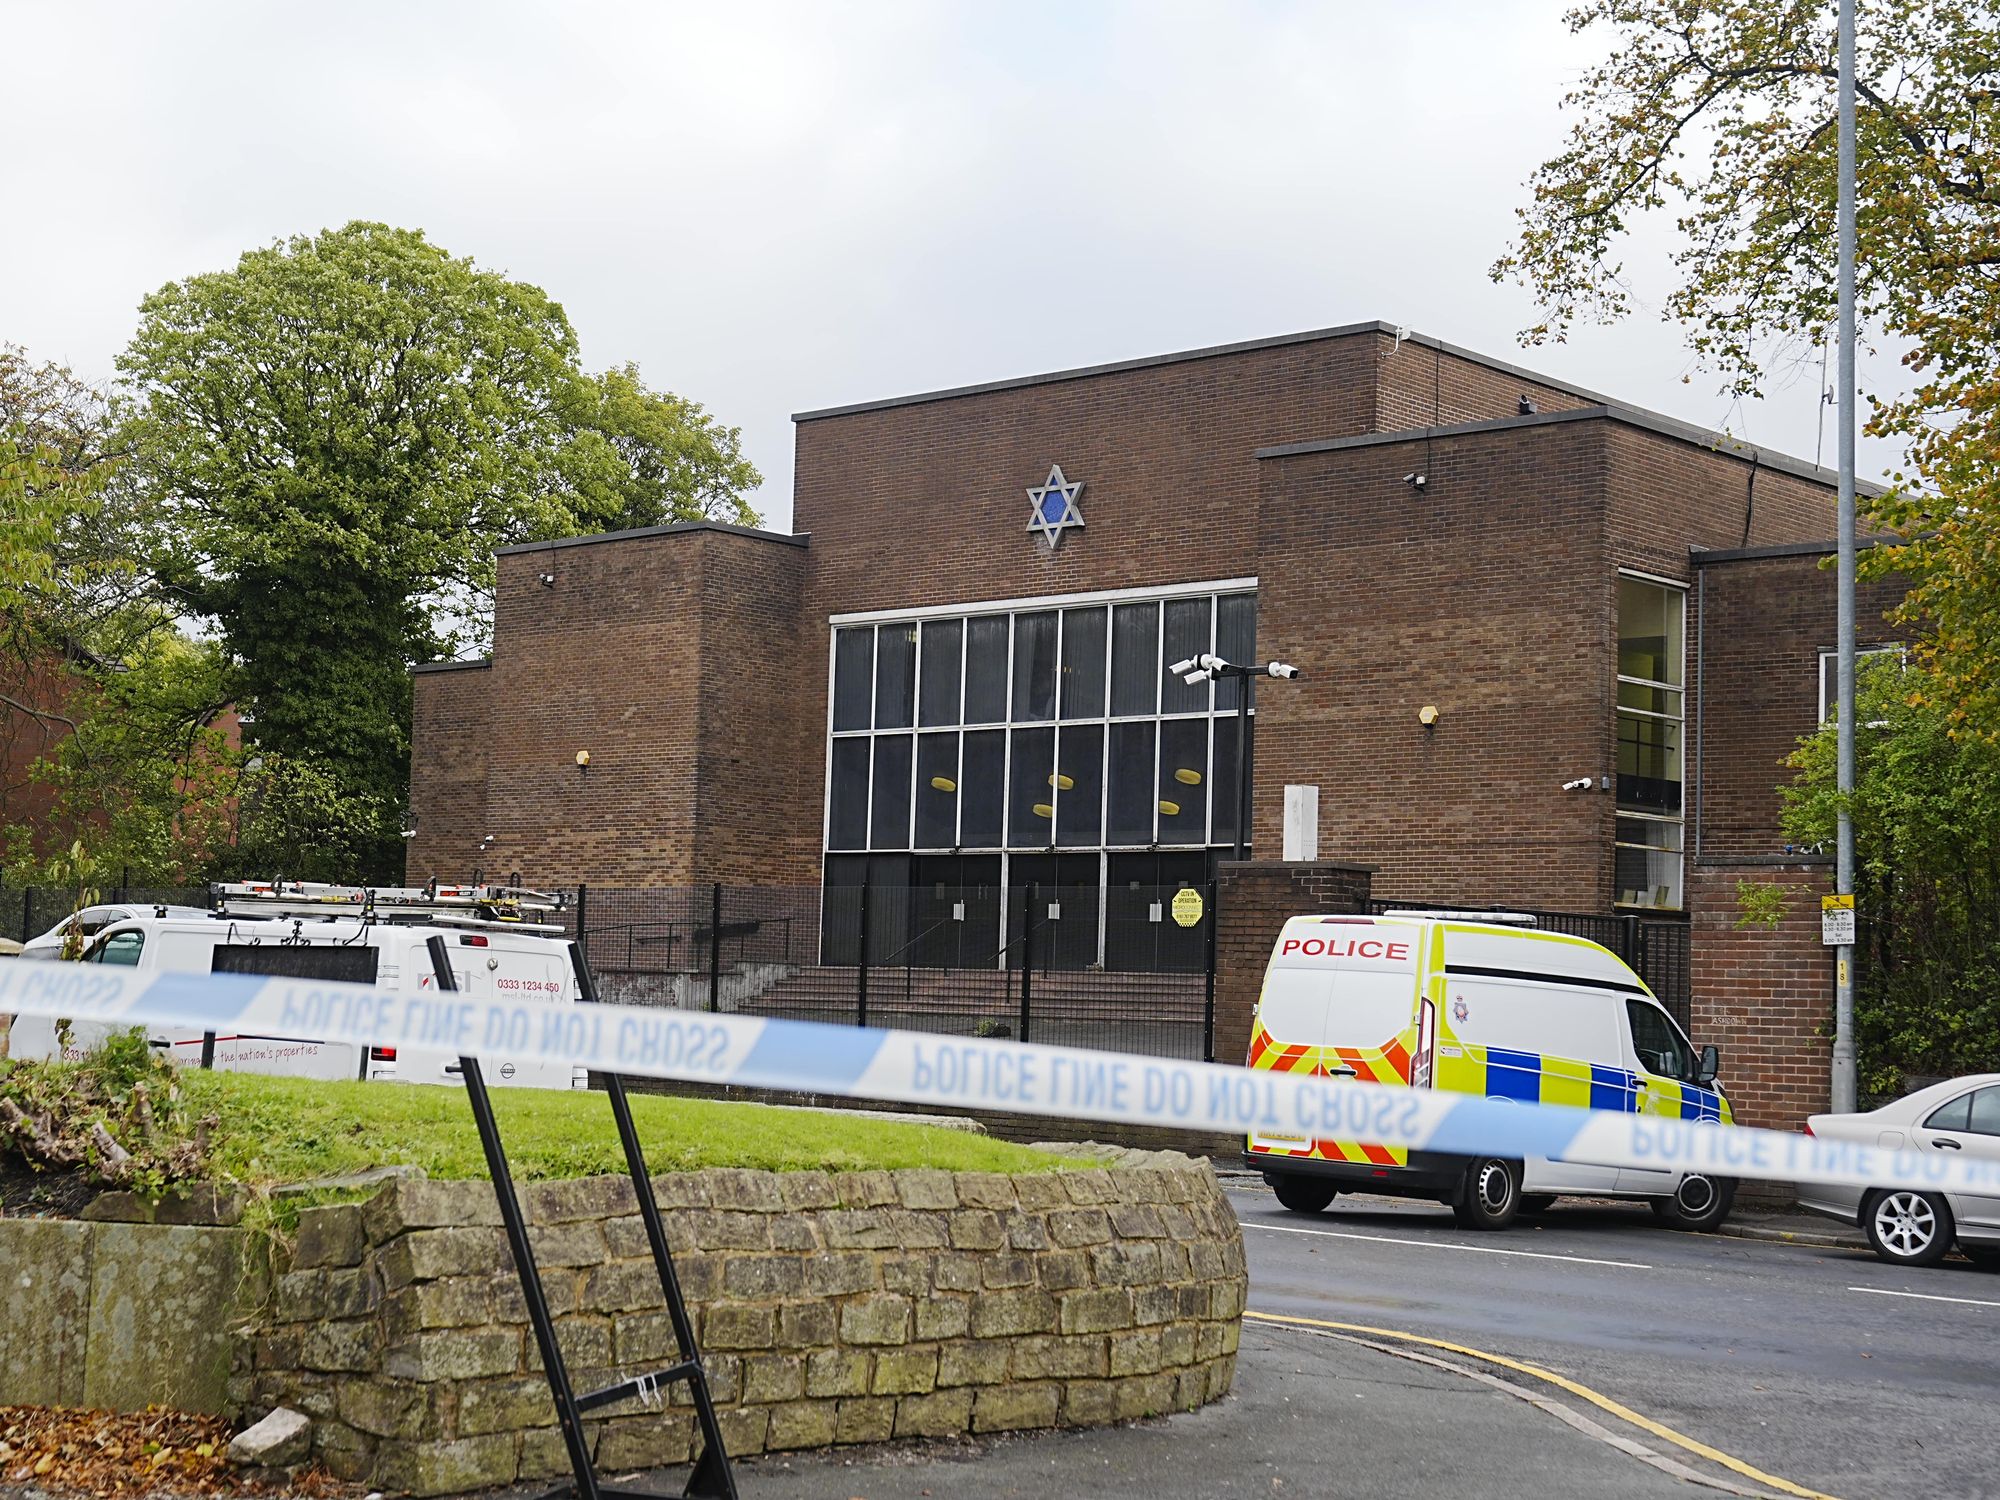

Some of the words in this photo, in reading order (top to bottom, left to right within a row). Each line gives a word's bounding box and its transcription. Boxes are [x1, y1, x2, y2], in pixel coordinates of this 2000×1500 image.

[1282, 939, 1409, 960] POLICE
[498, 978, 520, 989] 0333
[522, 980, 542, 990] 1234
[544, 982, 559, 992] 450
[220, 1050, 234, 1063] the
[238, 1046, 272, 1060] nation's
[276, 1044, 318, 1062] properties
